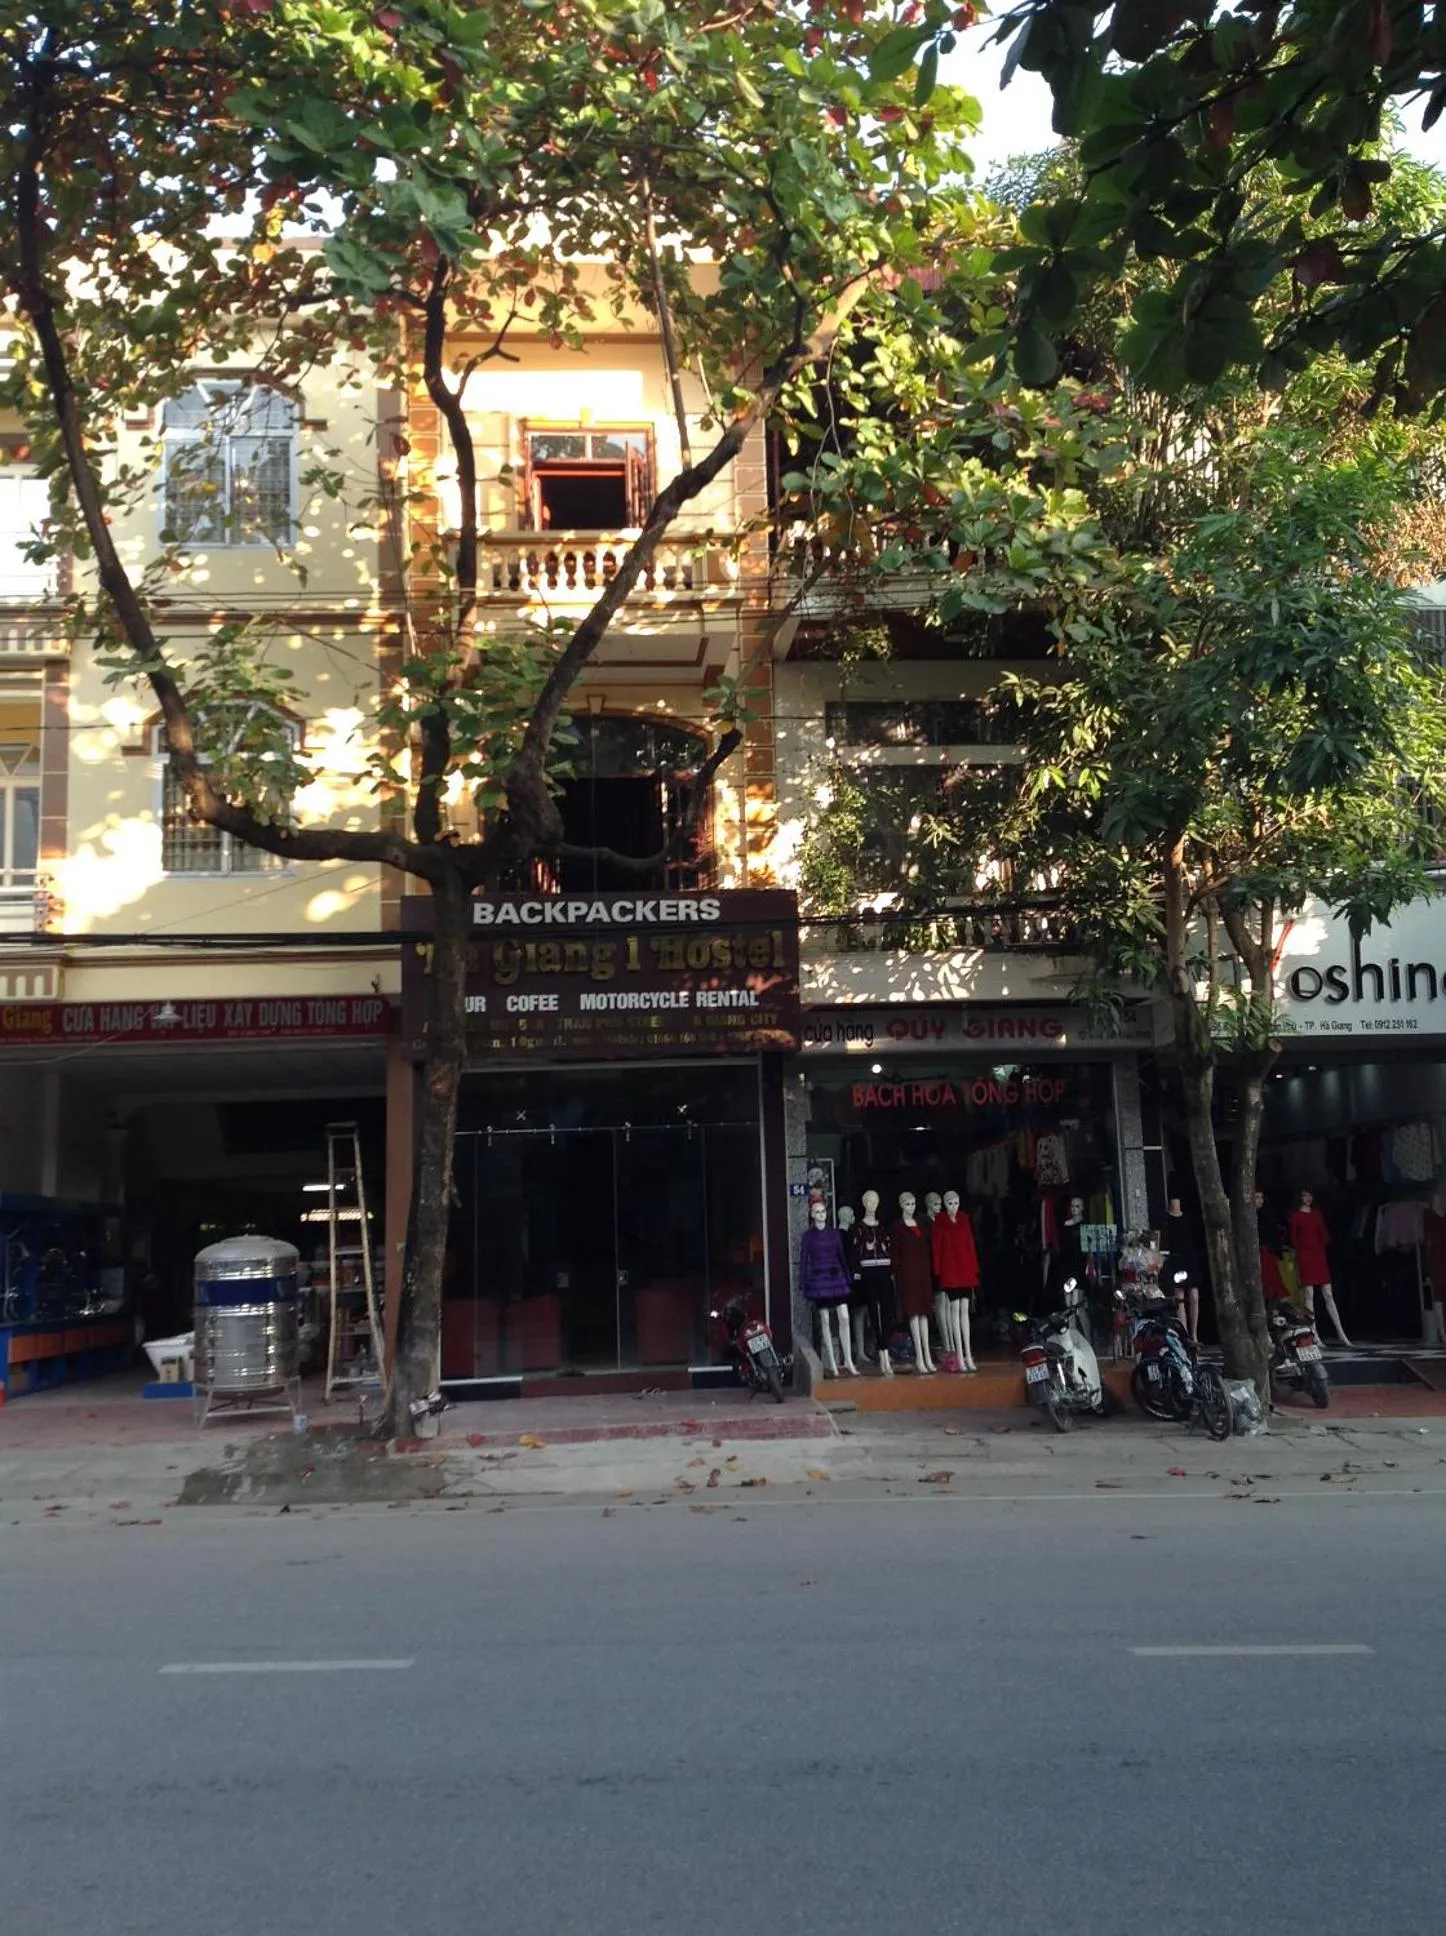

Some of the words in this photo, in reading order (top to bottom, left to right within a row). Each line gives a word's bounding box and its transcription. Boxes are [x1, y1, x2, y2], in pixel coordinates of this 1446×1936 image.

[473, 899, 721, 925] BACKPACKERS
[1289, 936, 1446, 1003] oshin
[506, 993, 560, 1012] COFEE
[580, 991, 690, 1010] MOTORCYCLE
[696, 990, 760, 1008] RENTAL
[962, 1017, 1063, 1039] GIANG
